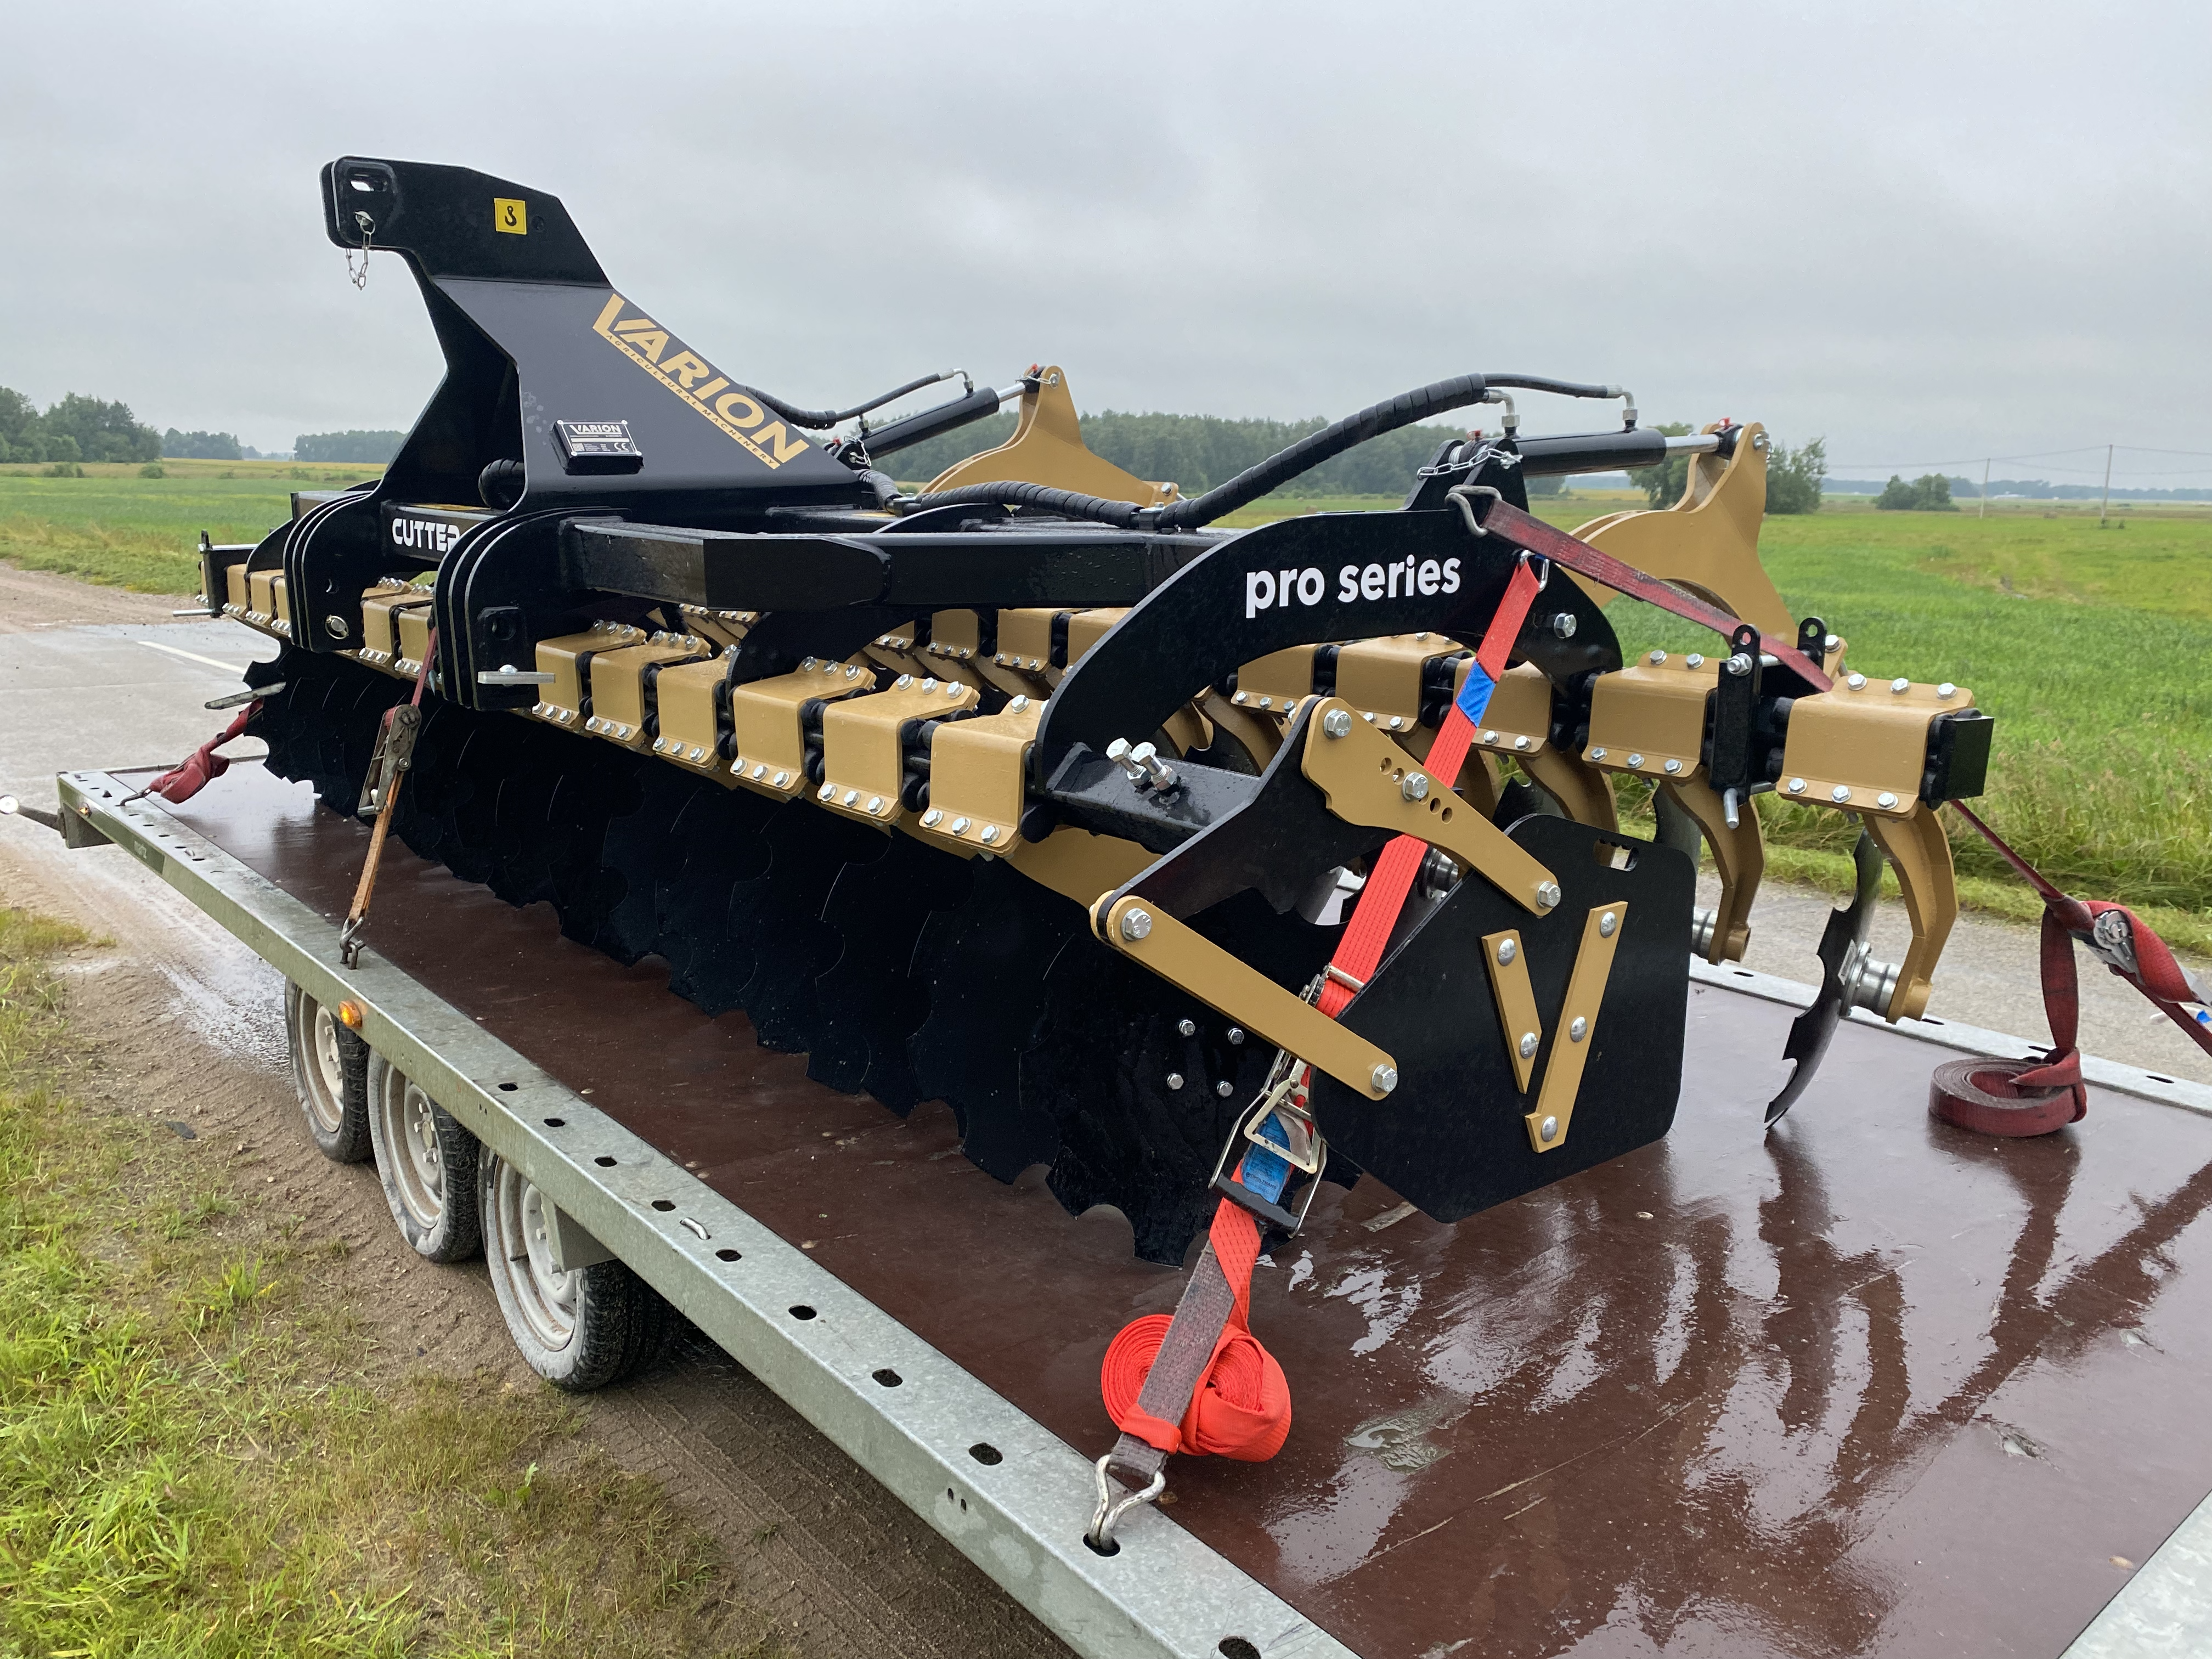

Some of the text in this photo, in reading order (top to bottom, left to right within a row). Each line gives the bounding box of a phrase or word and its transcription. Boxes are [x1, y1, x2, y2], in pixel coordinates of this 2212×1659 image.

[592, 293, 810, 466] VARION
[606, 335, 775, 465] AGRICULTURAL MACHINERY
[569, 425, 622, 434] VARION
[1246, 554, 1461, 618] pro series
